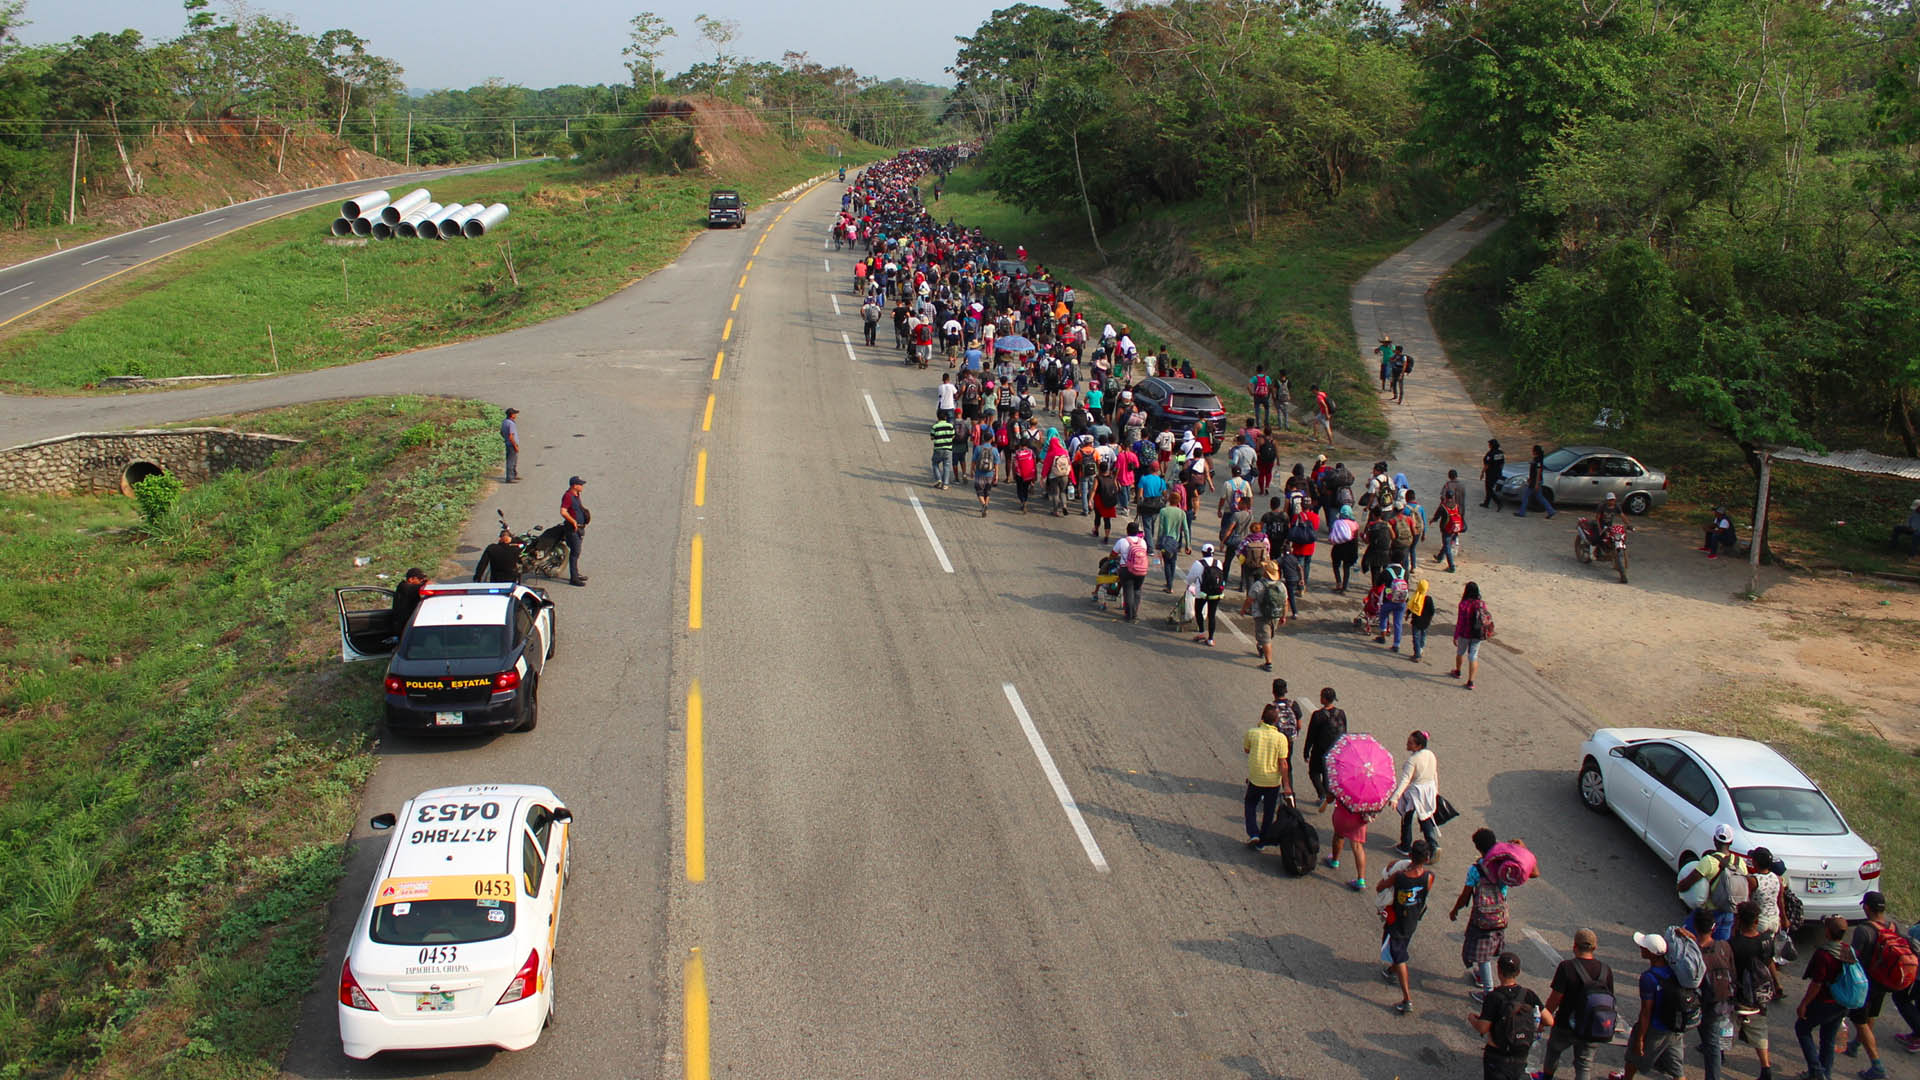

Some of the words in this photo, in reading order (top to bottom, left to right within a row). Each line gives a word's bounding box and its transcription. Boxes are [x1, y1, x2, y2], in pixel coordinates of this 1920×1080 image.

[406, 681, 444, 689] POLICIA
[451, 678, 492, 688] ESTATAL
[418, 802, 500, 823] 0453
[411, 828, 497, 844] 47-77-BHG
[474, 880, 511, 896] 0453
[418, 946, 457, 964] 0453
